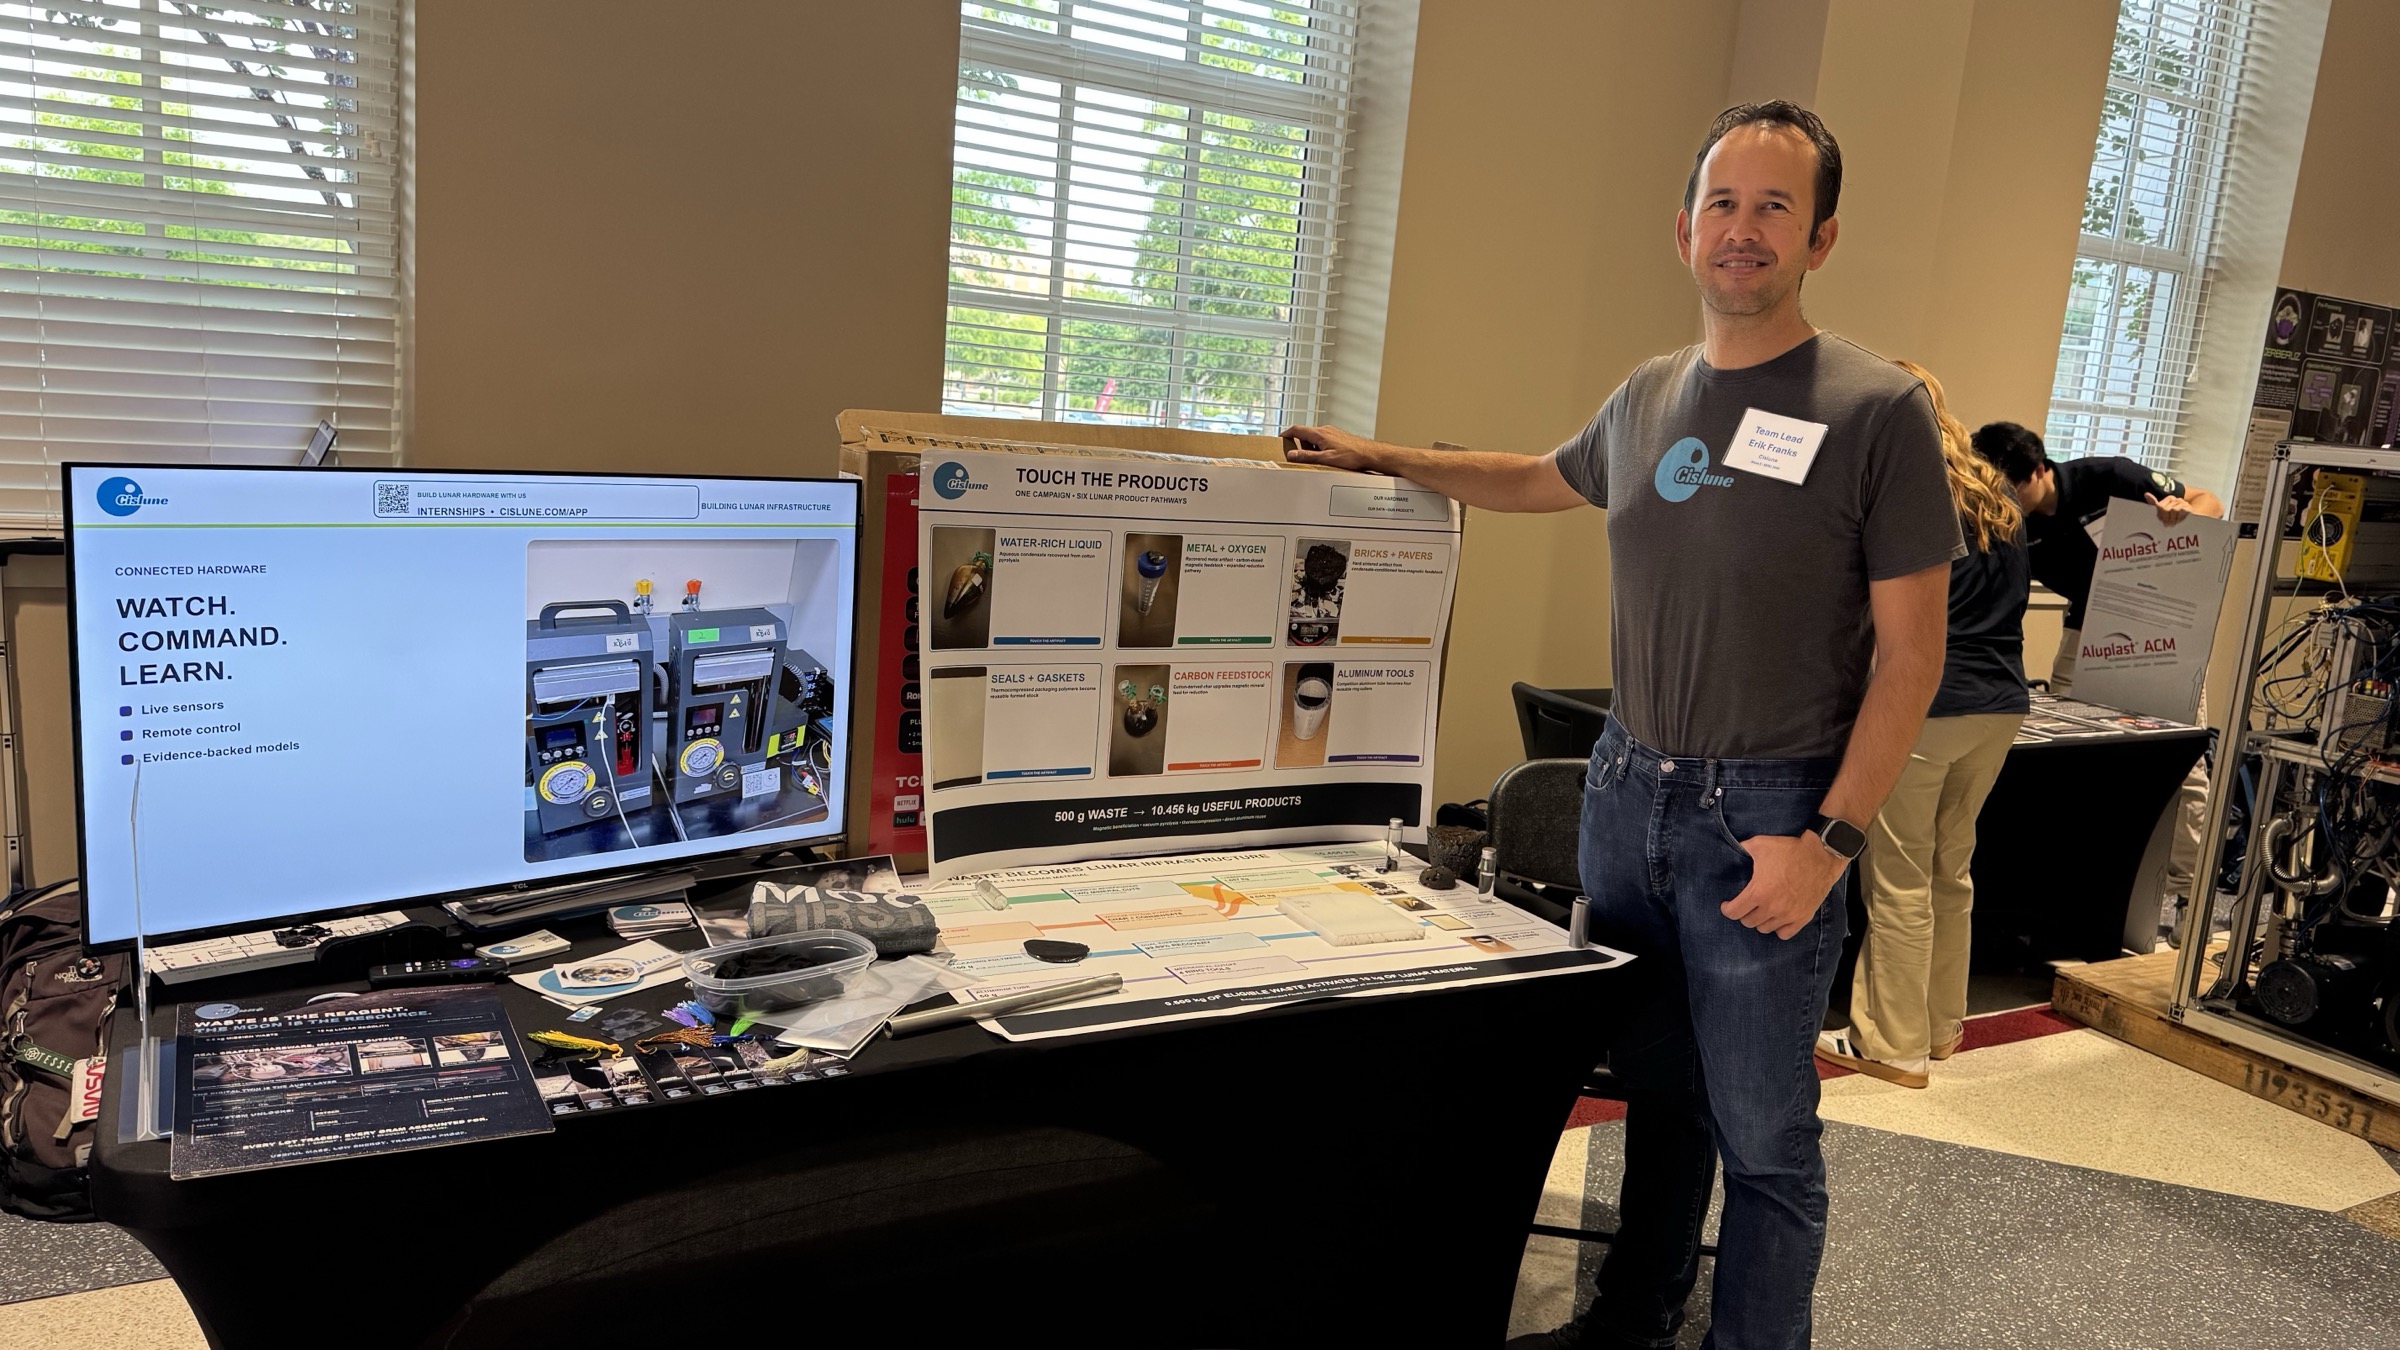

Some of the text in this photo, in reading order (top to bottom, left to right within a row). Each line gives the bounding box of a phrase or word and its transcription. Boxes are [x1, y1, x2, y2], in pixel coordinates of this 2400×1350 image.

[1756, 426, 1804, 444] Team Lead
[1748, 438, 1798, 458] Erik Franks
[948, 480, 988, 491] Cislune
[1016, 468, 1209, 492] TOUCH THE PRODUCTS
[1674, 465, 1734, 488] Cislune
[116, 494, 168, 506] Cislune
[1033, 491, 1071, 499] CAMPAIGN
[1089, 493, 1114, 501] LUNAR
[1115, 494, 1149, 502] PRODUCT
[1150, 496, 1188, 504] PATHWAYS
[418, 508, 588, 516] INTERNSHIPS CISLUNE.COM/APP
[701, 502, 832, 512] BUILDING LUNAR INFRASTRUCTURE
[1000, 538, 1102, 550] WATER-RICH LIQUID
[1186, 544, 1218, 552] METAL
[1228, 544, 1266, 554] OXYGEN
[2102, 542, 2158, 561] Aluplast
[2166, 534, 2200, 552] ACM
[1354, 549, 1388, 558] BRICKS
[1398, 551, 1433, 560] PAVERS
[115, 564, 267, 576] CONNECTED HARDWARE
[116, 596, 236, 619] WATCH.
[118, 626, 288, 652] COMMAND.
[2082, 642, 2137, 660] Aluplast
[2144, 638, 2176, 653] ACM
[120, 661, 233, 686] LEARN.
[991, 674, 1025, 684] SEALS
[1037, 674, 1085, 682] GASKETS
[1174, 670, 1271, 680] CARBON FEEDSTOCK
[1338, 670, 1383, 678] ALUMINUM
[141, 701, 224, 715] Live sensors
[142, 722, 241, 740] Remote control
[143, 741, 300, 763] Evidence-backed models
[1054, 796, 1302, 824] 500 g WASTE 10.456 kg USEFUL PRODUCTS
[896, 816, 915, 824] hulu
[947, 853, 1272, 882] WASTE BECOMES LUNAR INFRASTRUCTURE
[1223, 988, 1269, 998] ELIGIBLE
[1271, 983, 1306, 994] WASTE
[1307, 977, 1358, 989] ACTIVATES
[1400, 969, 1430, 978] LUNAR
[1433, 964, 1478, 974] MATERIAL
[194, 1016, 257, 1028] WASTE
[284, 1012, 319, 1020] THE
[324, 1006, 408, 1018] REAGENT.
[229, 1022, 282, 1032] MOON
[344, 1010, 432, 1022] RESOURCE.
[408, 1119, 466, 1130] ACCOUNTED
